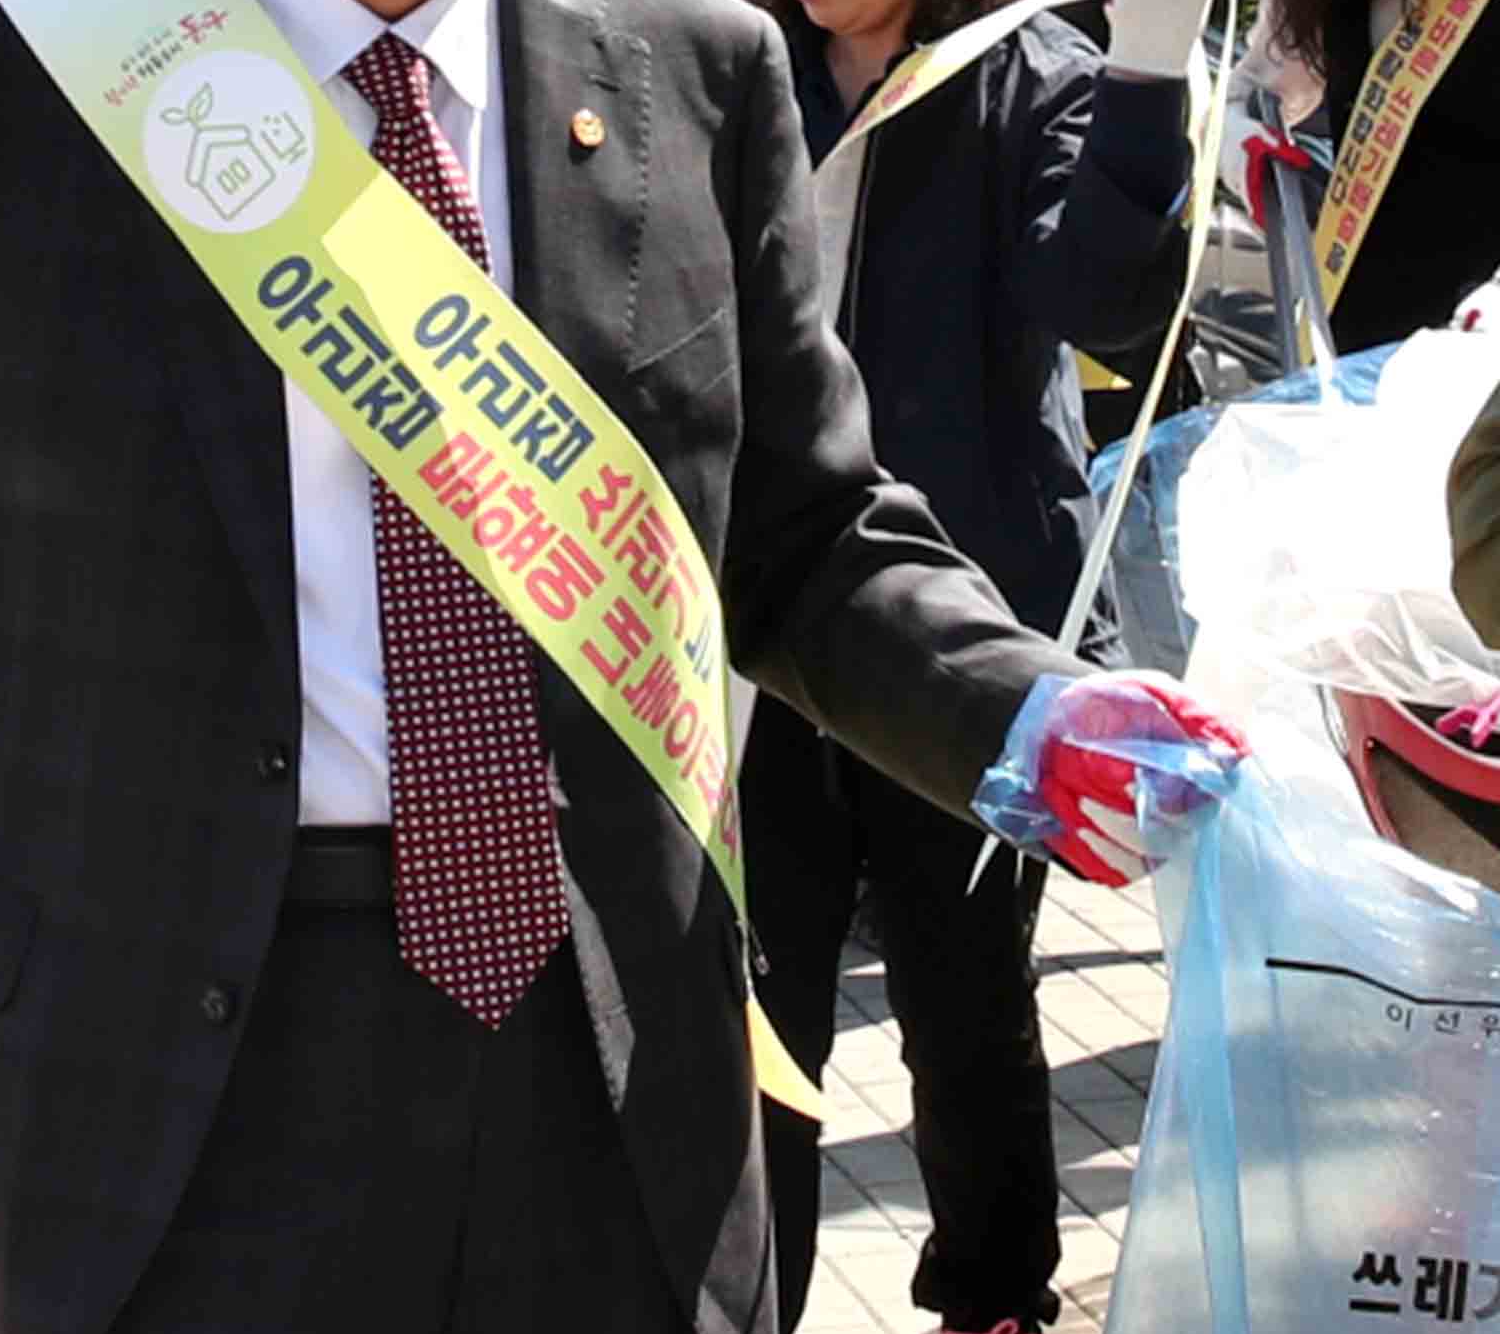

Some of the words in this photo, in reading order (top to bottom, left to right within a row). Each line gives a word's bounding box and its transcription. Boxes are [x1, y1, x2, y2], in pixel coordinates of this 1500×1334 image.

[257, 254, 445, 452] 우리집
[414, 293, 596, 485] 우리집
[418, 432, 603, 625] 문앞에
[1385, 1002, 1413, 1032] 이
[1433, 1011, 1463, 1036] 선
